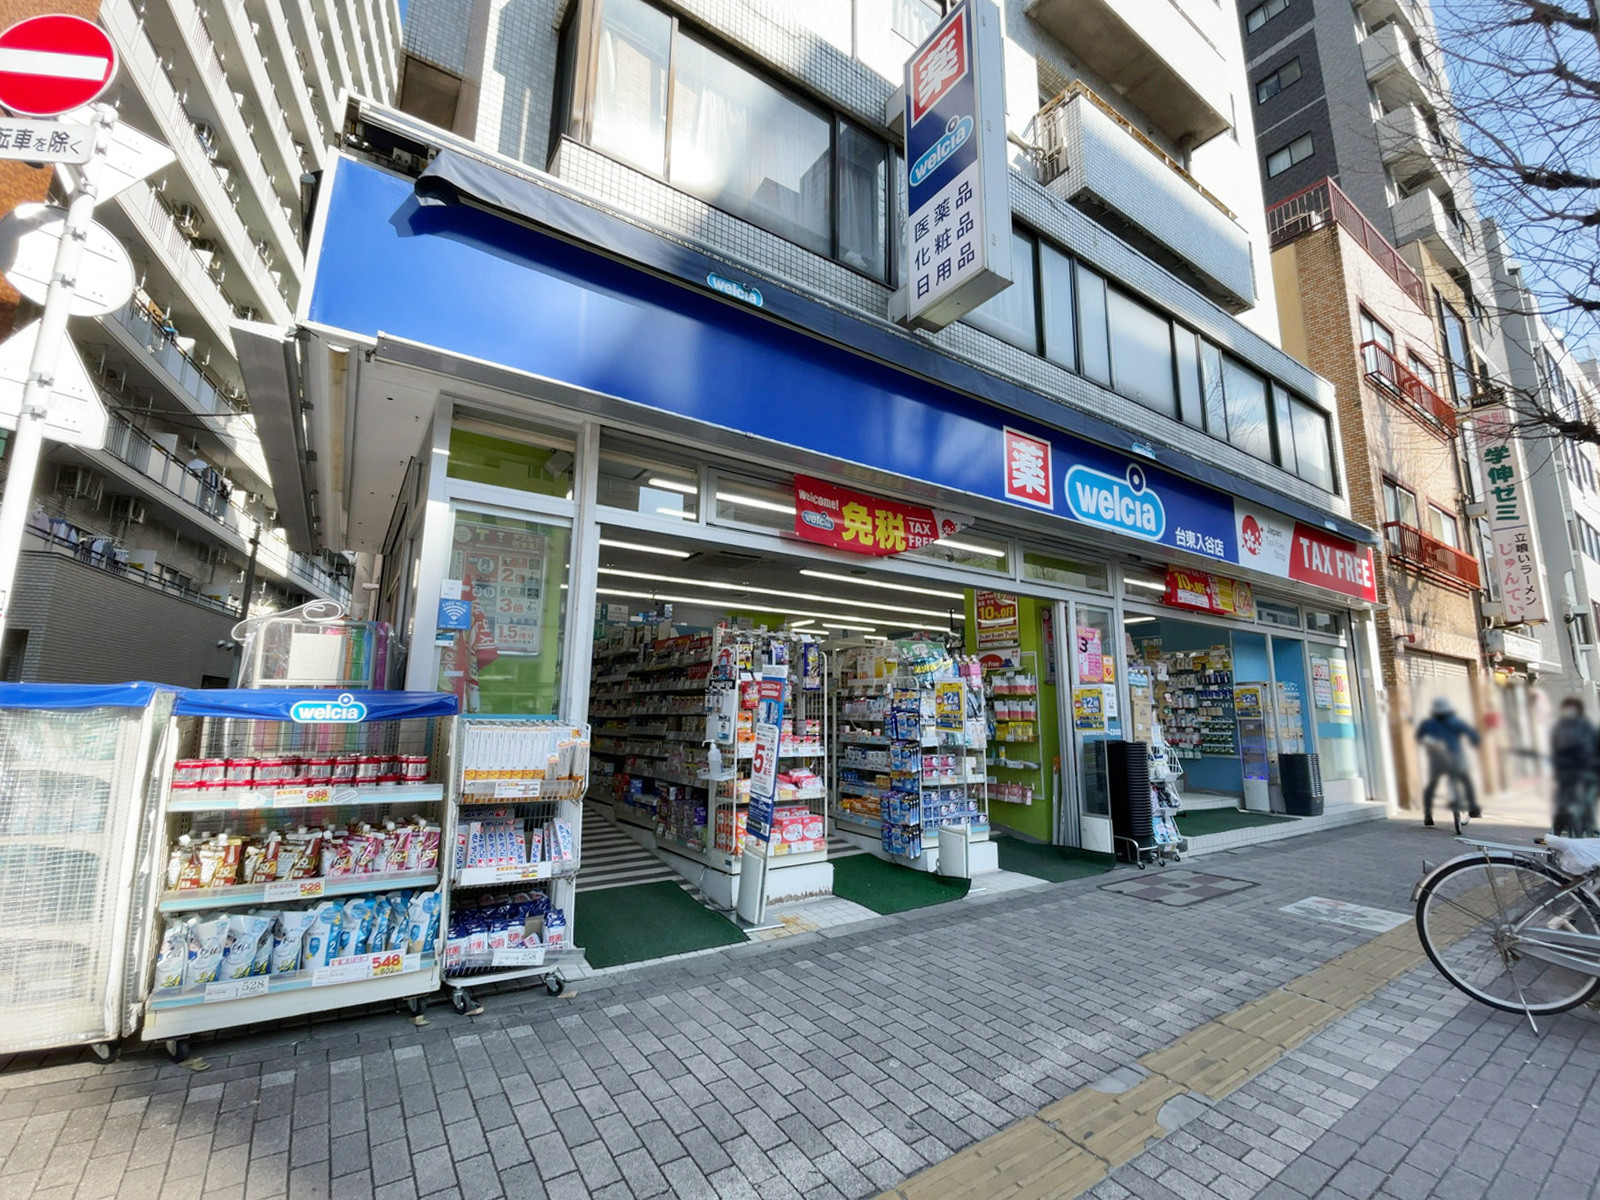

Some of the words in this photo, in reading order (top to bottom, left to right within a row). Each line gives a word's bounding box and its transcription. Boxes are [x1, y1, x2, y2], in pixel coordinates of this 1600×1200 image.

[918, 28, 959, 108] 薬
[914, 124, 967, 180] welcia
[914, 181, 973, 243] 医薬品
[914, 211, 974, 271] 化粧品
[712, 277, 757, 303] welcia
[916, 242, 976, 300] 日用品
[1011, 441, 1047, 496] 薬
[1484, 445, 1520, 520] 学伸ゼミ
[841, 500, 906, 551] 免税
[909, 521, 932, 535] TAX
[1075, 481, 1157, 532] welcia
[1175, 527, 1224, 558] 台東入谷店
[1299, 536, 1333, 576] TAX
[1336, 550, 1371, 588] FREE
[299, 702, 359, 720] welcia
[306, 789, 328, 800] 698
[300, 881, 321, 893] 528
[241, 980, 264, 992] 528
[371, 954, 401, 969] 548
